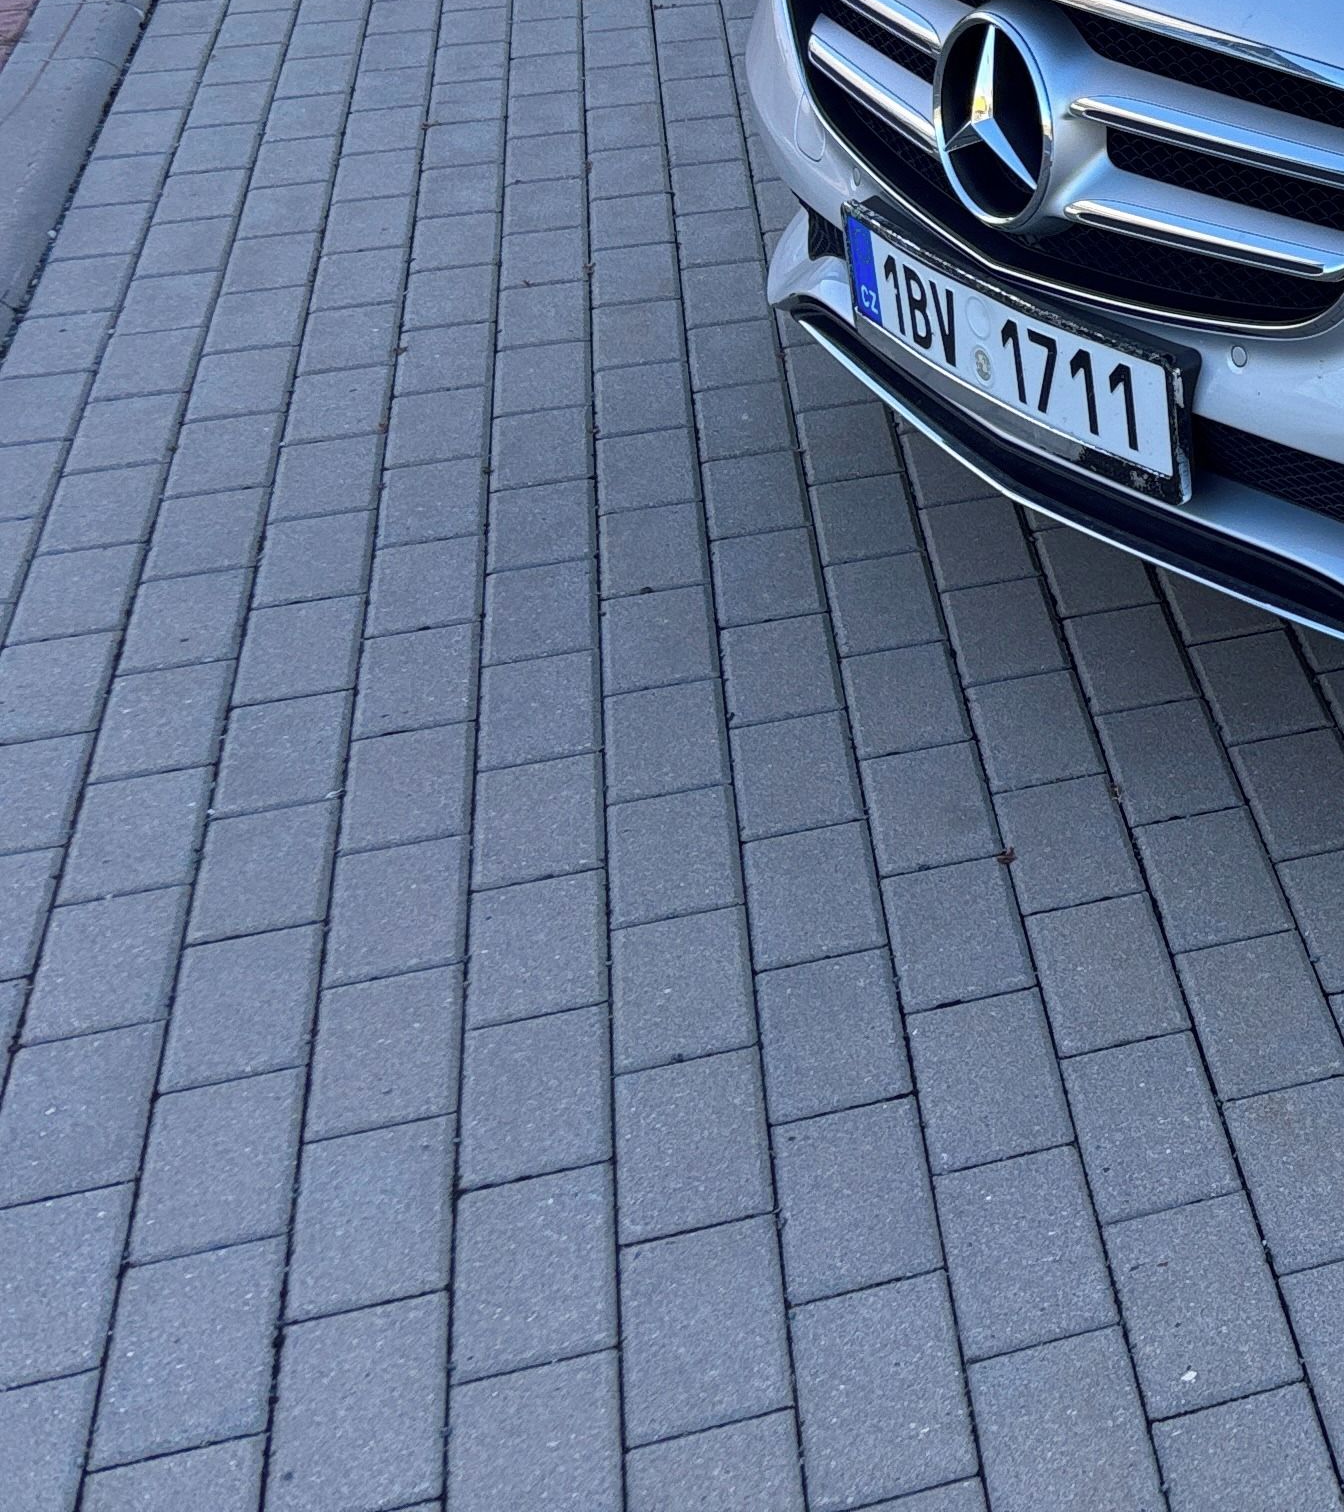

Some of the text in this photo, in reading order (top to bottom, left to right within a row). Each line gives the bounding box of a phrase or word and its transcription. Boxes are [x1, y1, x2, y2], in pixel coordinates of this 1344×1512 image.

[860, 284, 880, 314] CZ
[883, 253, 1140, 452] 1BV 1711
